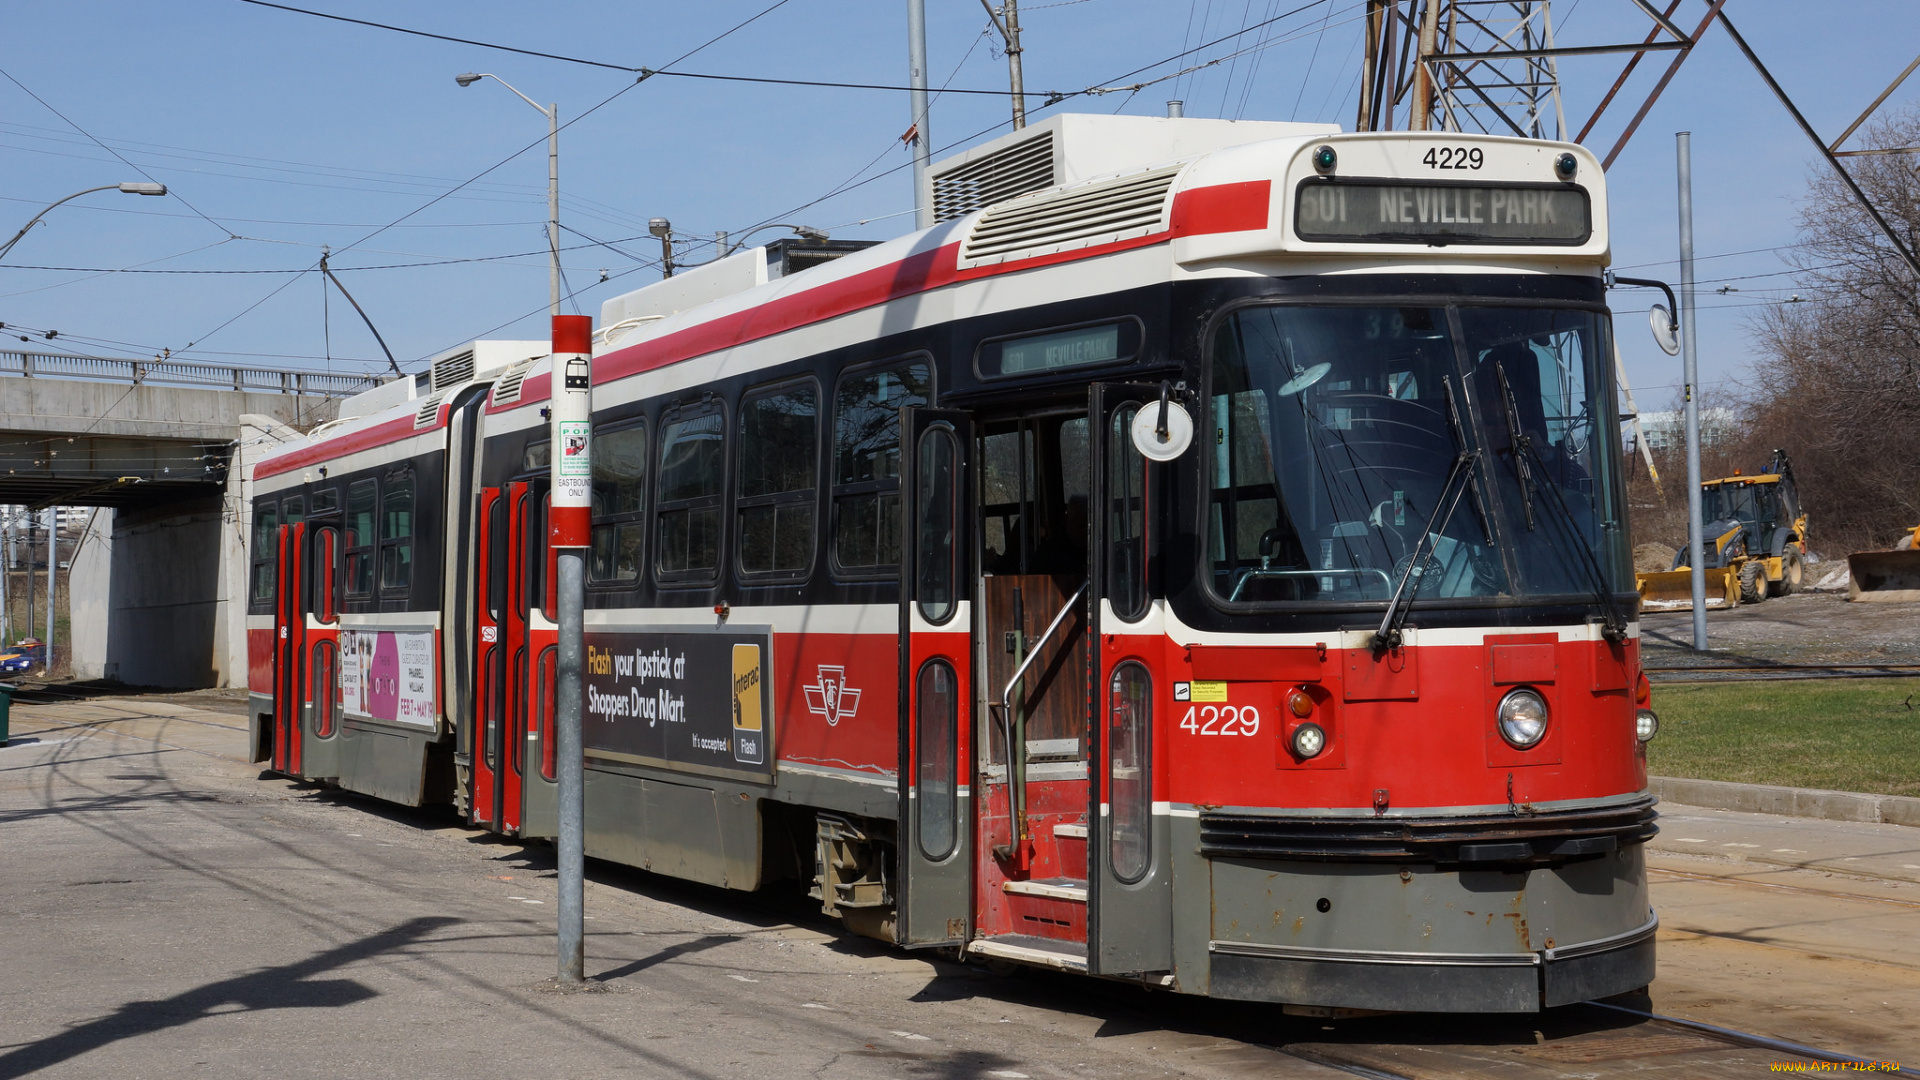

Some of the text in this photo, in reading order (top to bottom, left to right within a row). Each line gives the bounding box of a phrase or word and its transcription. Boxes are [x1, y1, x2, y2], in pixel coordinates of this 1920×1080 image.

[1422, 147, 1484, 170] 4229
[1301, 185, 1556, 225] 501 NEVILLE PARK
[1046, 342, 1083, 366] NEVILLE
[1084, 338, 1109, 360] PARK
[558, 478, 591, 487] EASTBOUND
[568, 488, 584, 497] ONLY
[588, 645, 686, 685] Flash your lipstick at
[733, 666, 760, 698] Interac
[401, 698, 410, 716] FEB
[416, 700, 427, 718] MAY
[588, 683, 686, 728] Shoppers Drug Mart.
[1179, 705, 1260, 737] 4229
[692, 733, 727, 754] It's accepted
[740, 738, 757, 755] Flash
